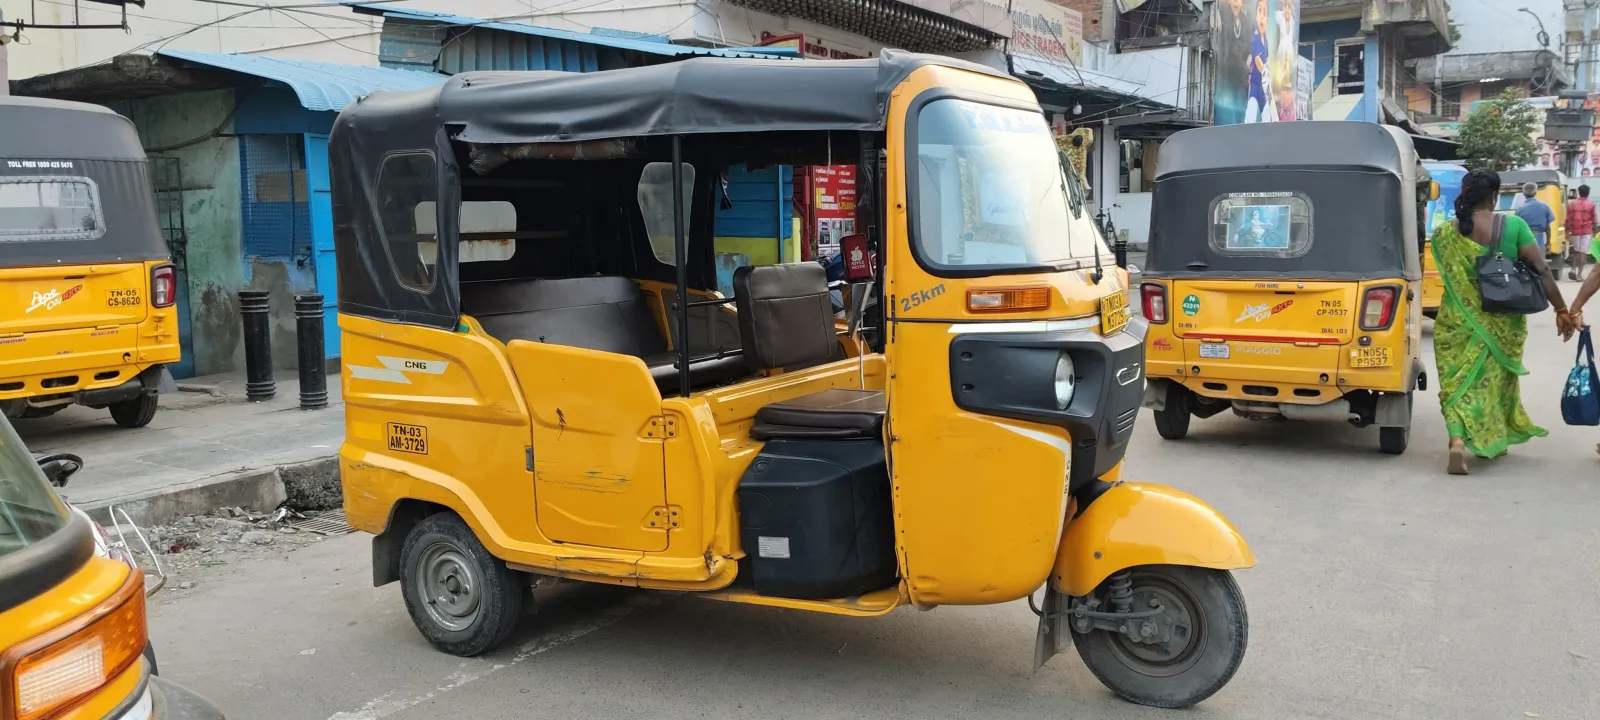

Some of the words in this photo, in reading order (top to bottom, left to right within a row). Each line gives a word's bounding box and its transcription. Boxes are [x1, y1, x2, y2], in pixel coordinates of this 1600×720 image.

[1012, 28, 1031, 50] RICE
[1033, 35, 1068, 58] TRADERS
[110, 290, 137, 298] TN-05
[901, 283, 946, 312] 25km
[108, 297, 141, 307] CS-8620
[1235, 346, 1282, 355] PIAGGIO
[1357, 348, 1388, 357] TN05C
[405, 360, 427, 370] CNG
[393, 424, 421, 438] TN-03
[390, 435, 425, 452] AM-3729
